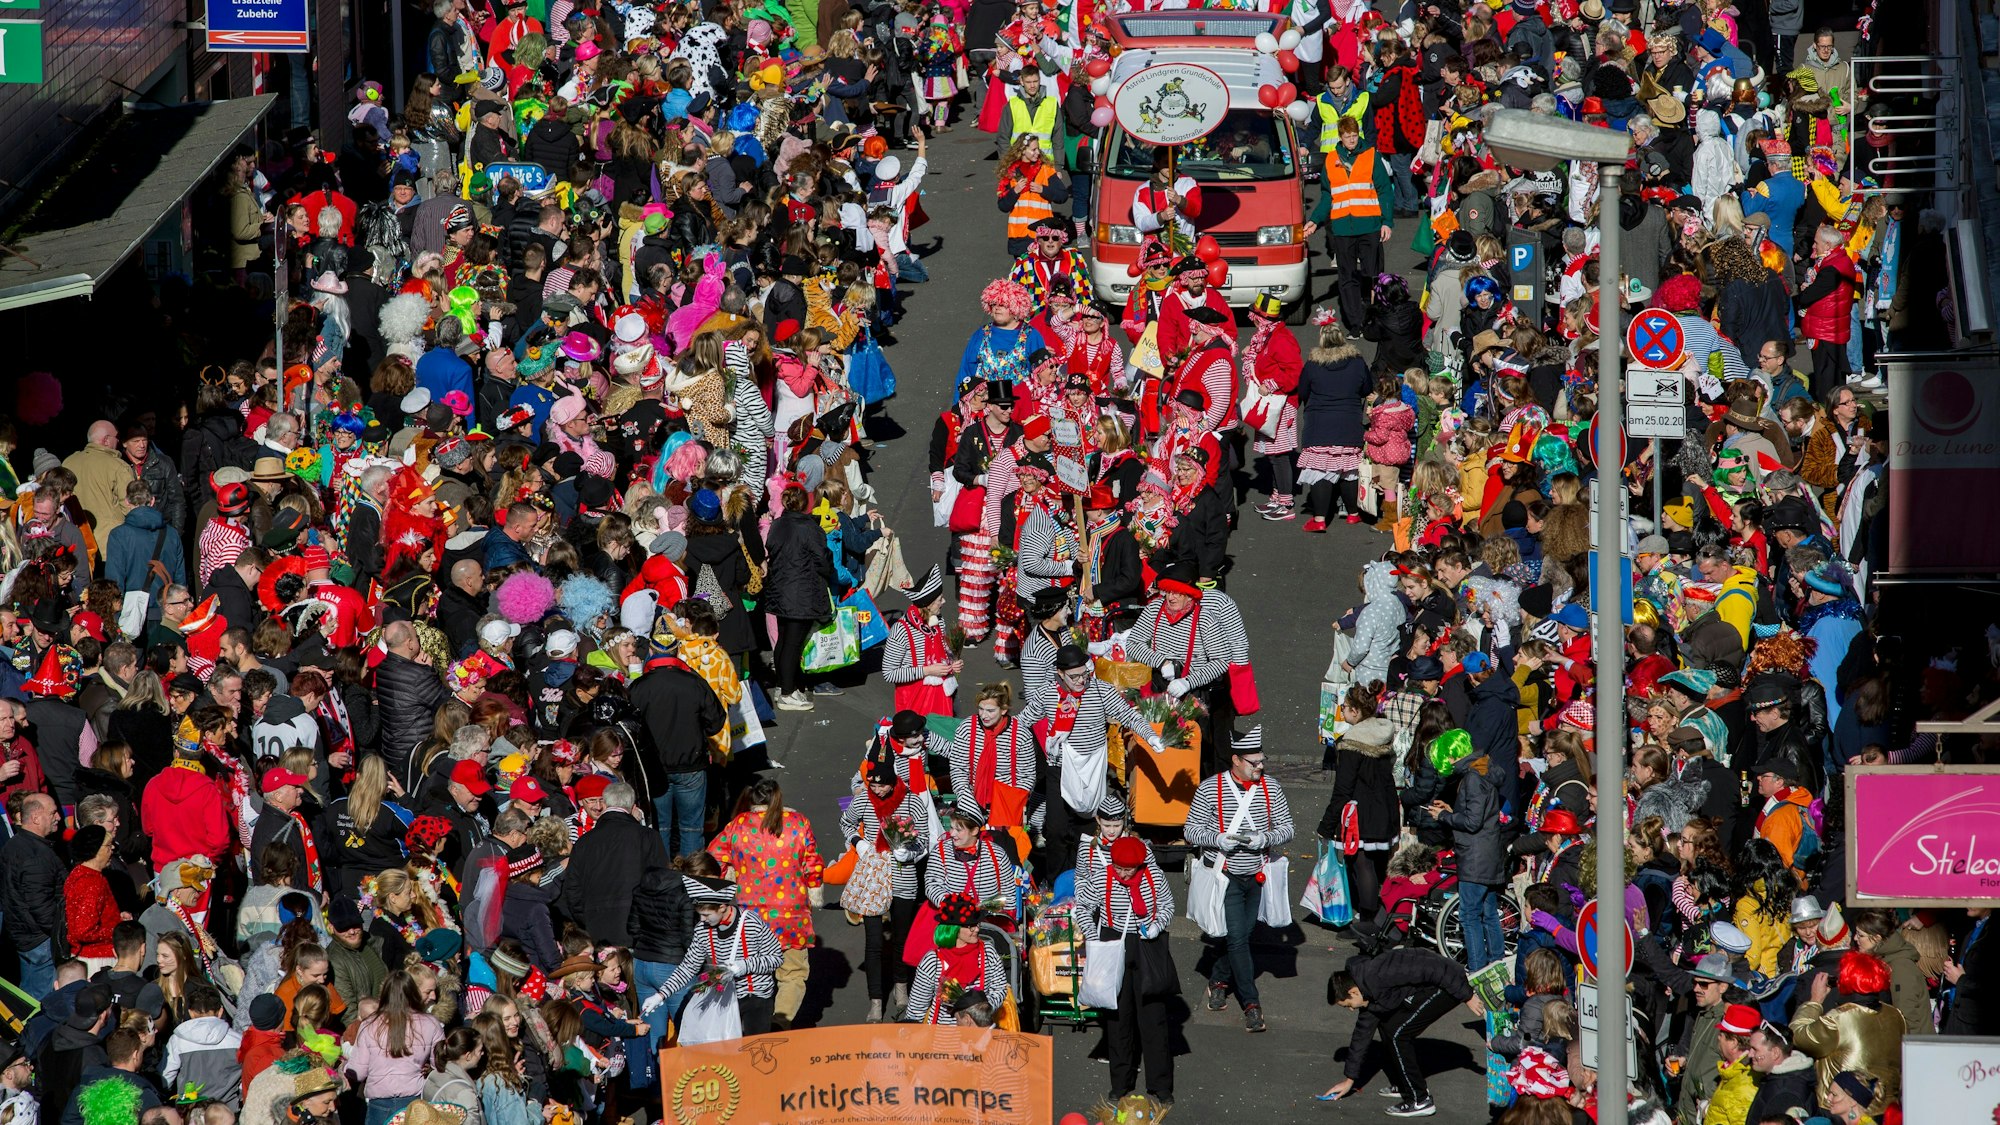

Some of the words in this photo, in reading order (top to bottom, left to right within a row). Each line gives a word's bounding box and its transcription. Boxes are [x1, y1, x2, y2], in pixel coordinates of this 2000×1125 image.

[237, 9, 278, 19] Zubehör
[1125, 76, 1146, 91] Astrid
[1146, 68, 1179, 80] Lindgren
[1180, 67, 1222, 90] Grundschule
[1161, 128, 1203, 142] Borsigstraße
[1514, 247, 1527, 267] P
[1629, 417, 1644, 426] am
[1645, 416, 1684, 426] 25.02.20
[1896, 441, 1938, 456] Due
[1944, 439, 1994, 455] Lune
[320, 591, 341, 604] KÖLN
[809, 1056, 821, 1065] 50
[691, 1078, 720, 1104] 50
